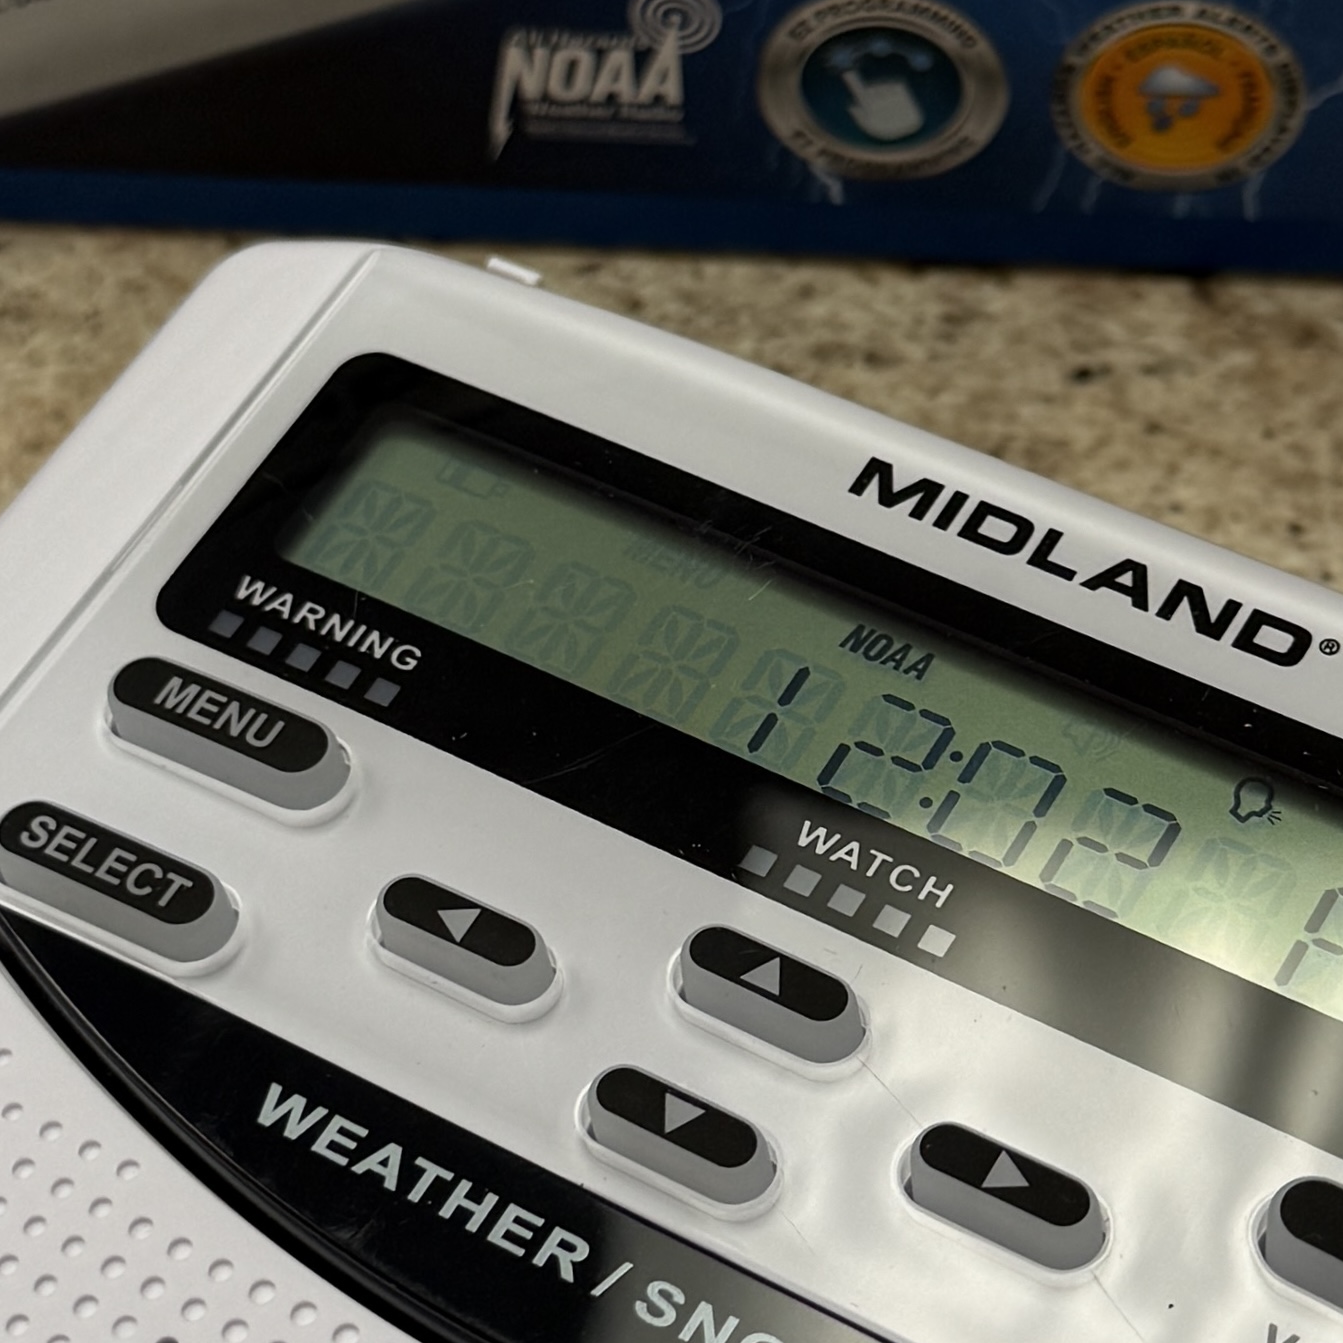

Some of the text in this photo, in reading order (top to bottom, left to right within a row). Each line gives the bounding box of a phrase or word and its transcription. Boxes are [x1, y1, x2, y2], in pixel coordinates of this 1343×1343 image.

[499, 20, 686, 106] NOAA
[234, 573, 424, 673] WARNING
[839, 623, 937, 683] NOAA
[153, 675, 287, 751] MENU
[18, 814, 194, 912] SELECT
[797, 817, 955, 910] WATCH
[256, 1081, 592, 1285] WEATHER
